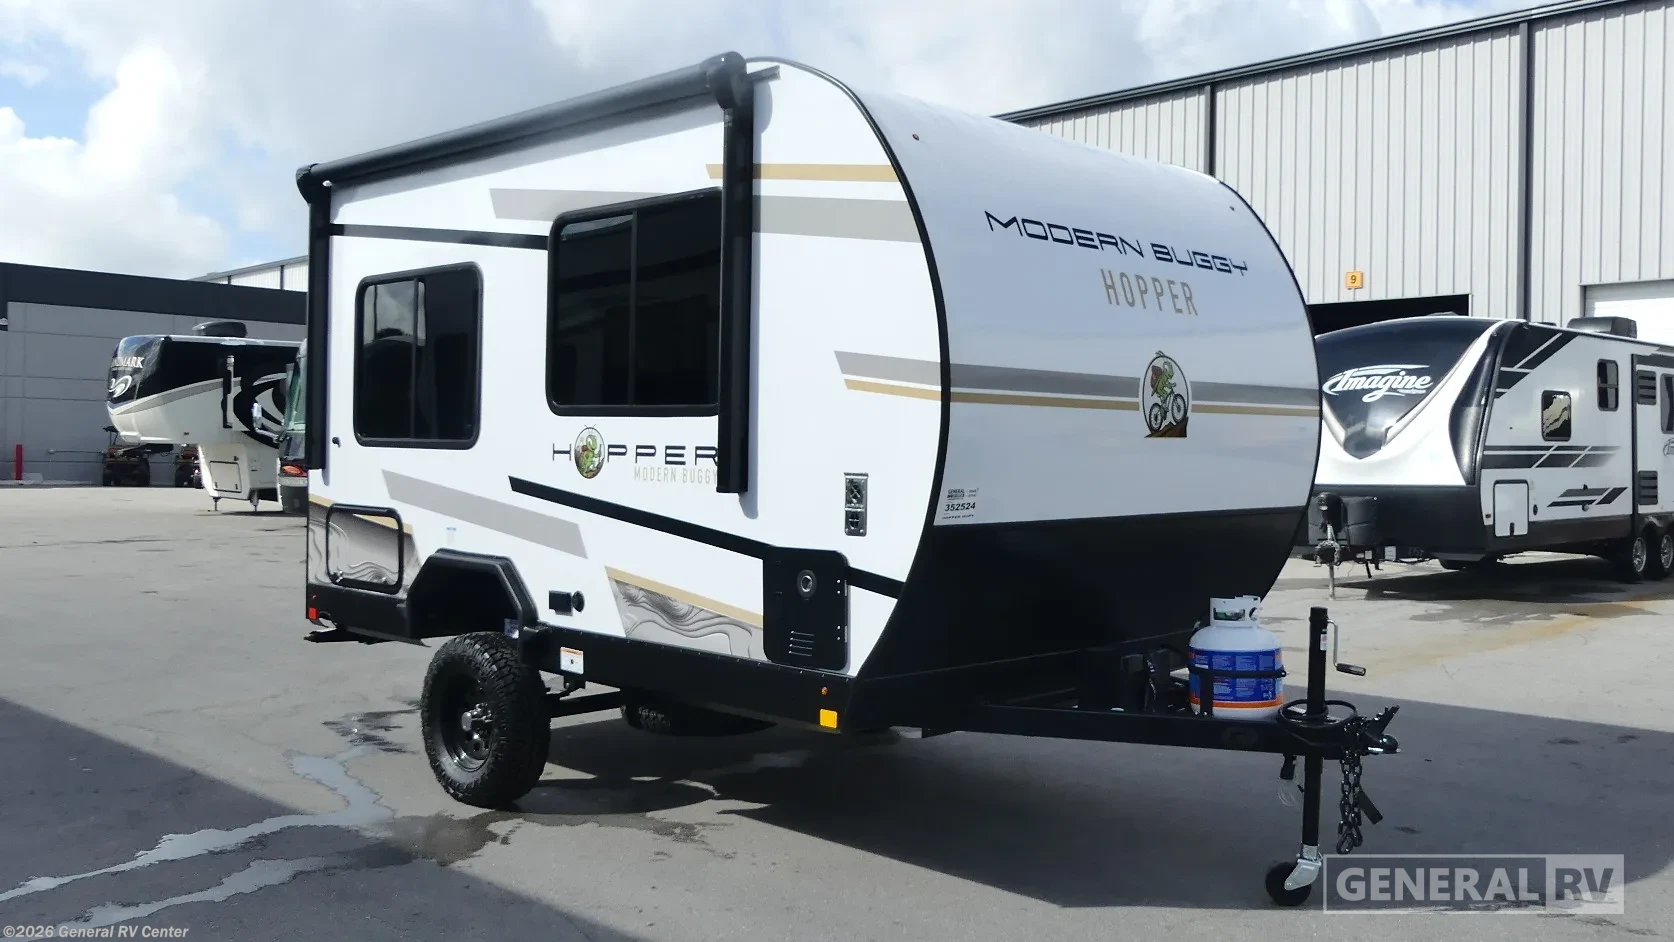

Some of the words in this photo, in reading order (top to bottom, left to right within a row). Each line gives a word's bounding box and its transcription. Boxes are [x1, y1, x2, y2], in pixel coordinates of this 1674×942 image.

[985, 211, 1144, 258] MODERN
[1150, 242, 1248, 276] BUGGY
[1100, 268, 1198, 316] HOPPER
[1350, 274, 1357, 284] 9
[1325, 367, 1434, 403] Imagine
[634, 466, 676, 482] MODERN
[945, 502, 976, 512] 352524
